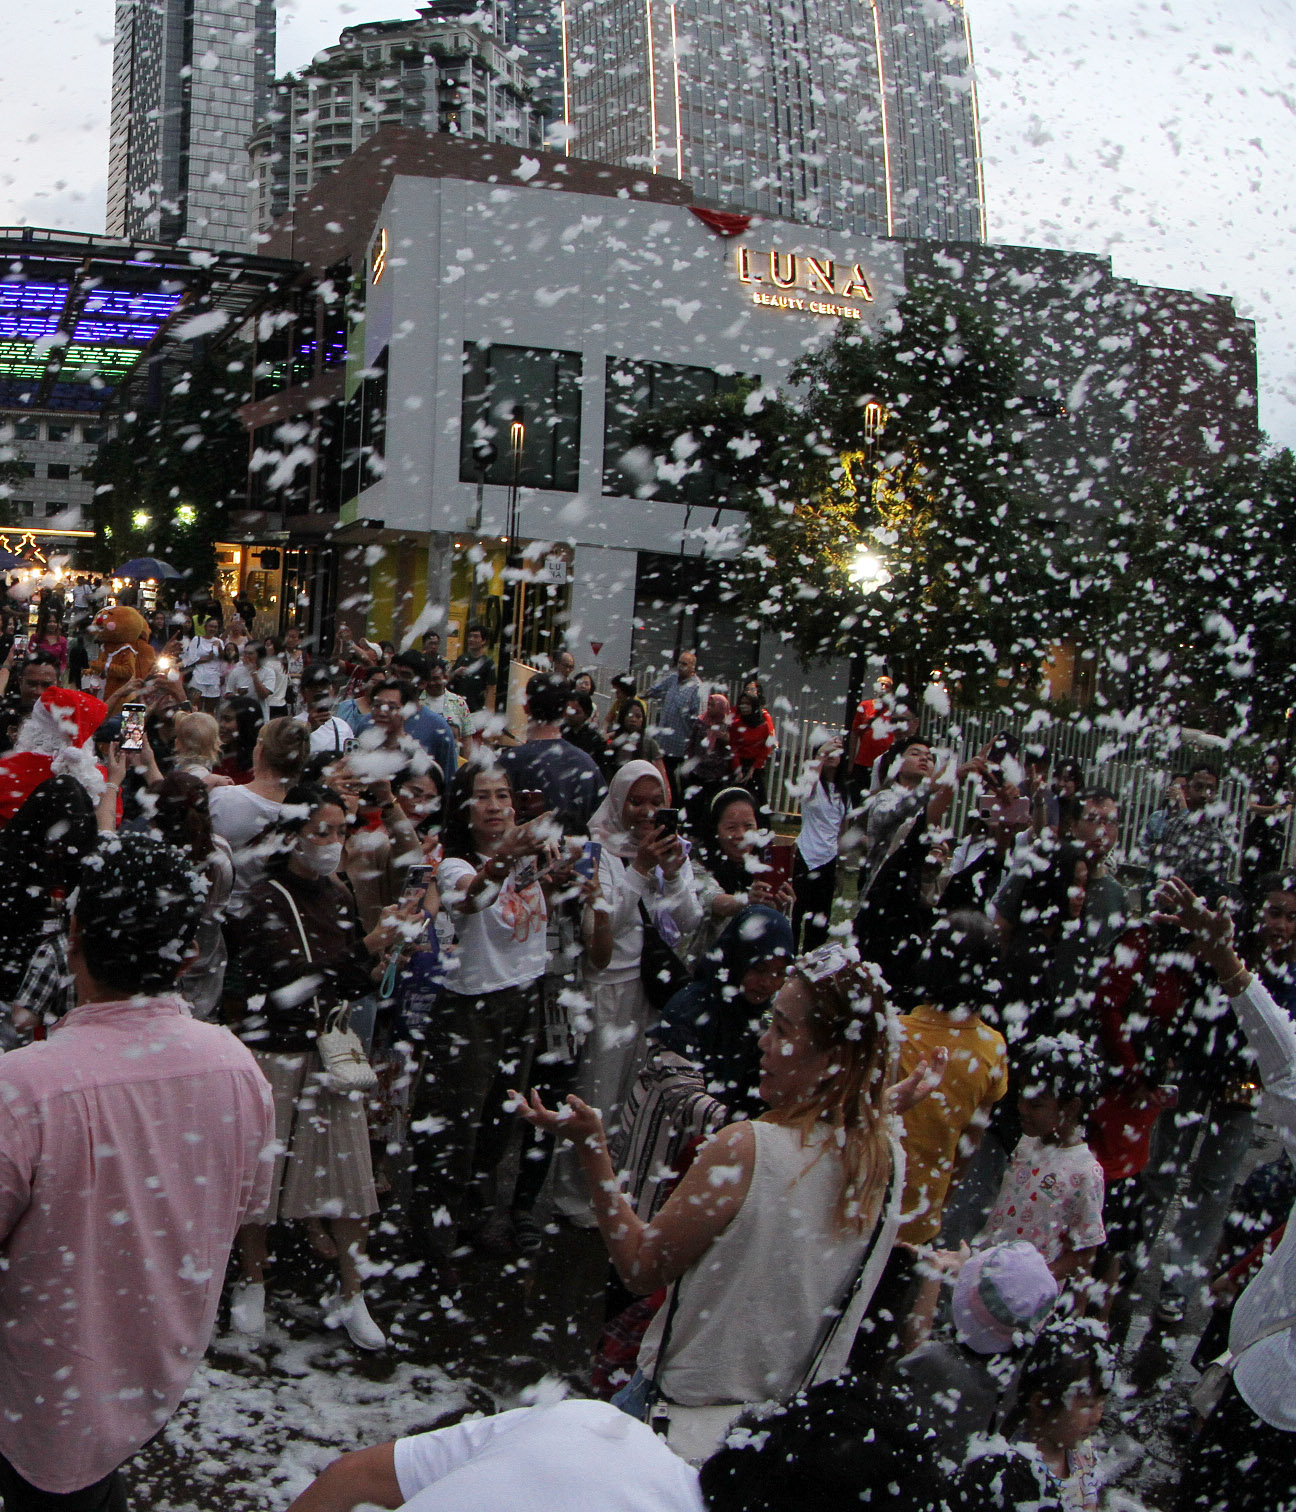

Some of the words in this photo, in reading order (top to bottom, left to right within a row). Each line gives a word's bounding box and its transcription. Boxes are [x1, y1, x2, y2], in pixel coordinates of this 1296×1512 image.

[738, 245, 874, 302] LUNA
[753, 291, 804, 311] BEAUTY
[809, 300, 862, 320] CENTER
[549, 562, 561, 570] LU
